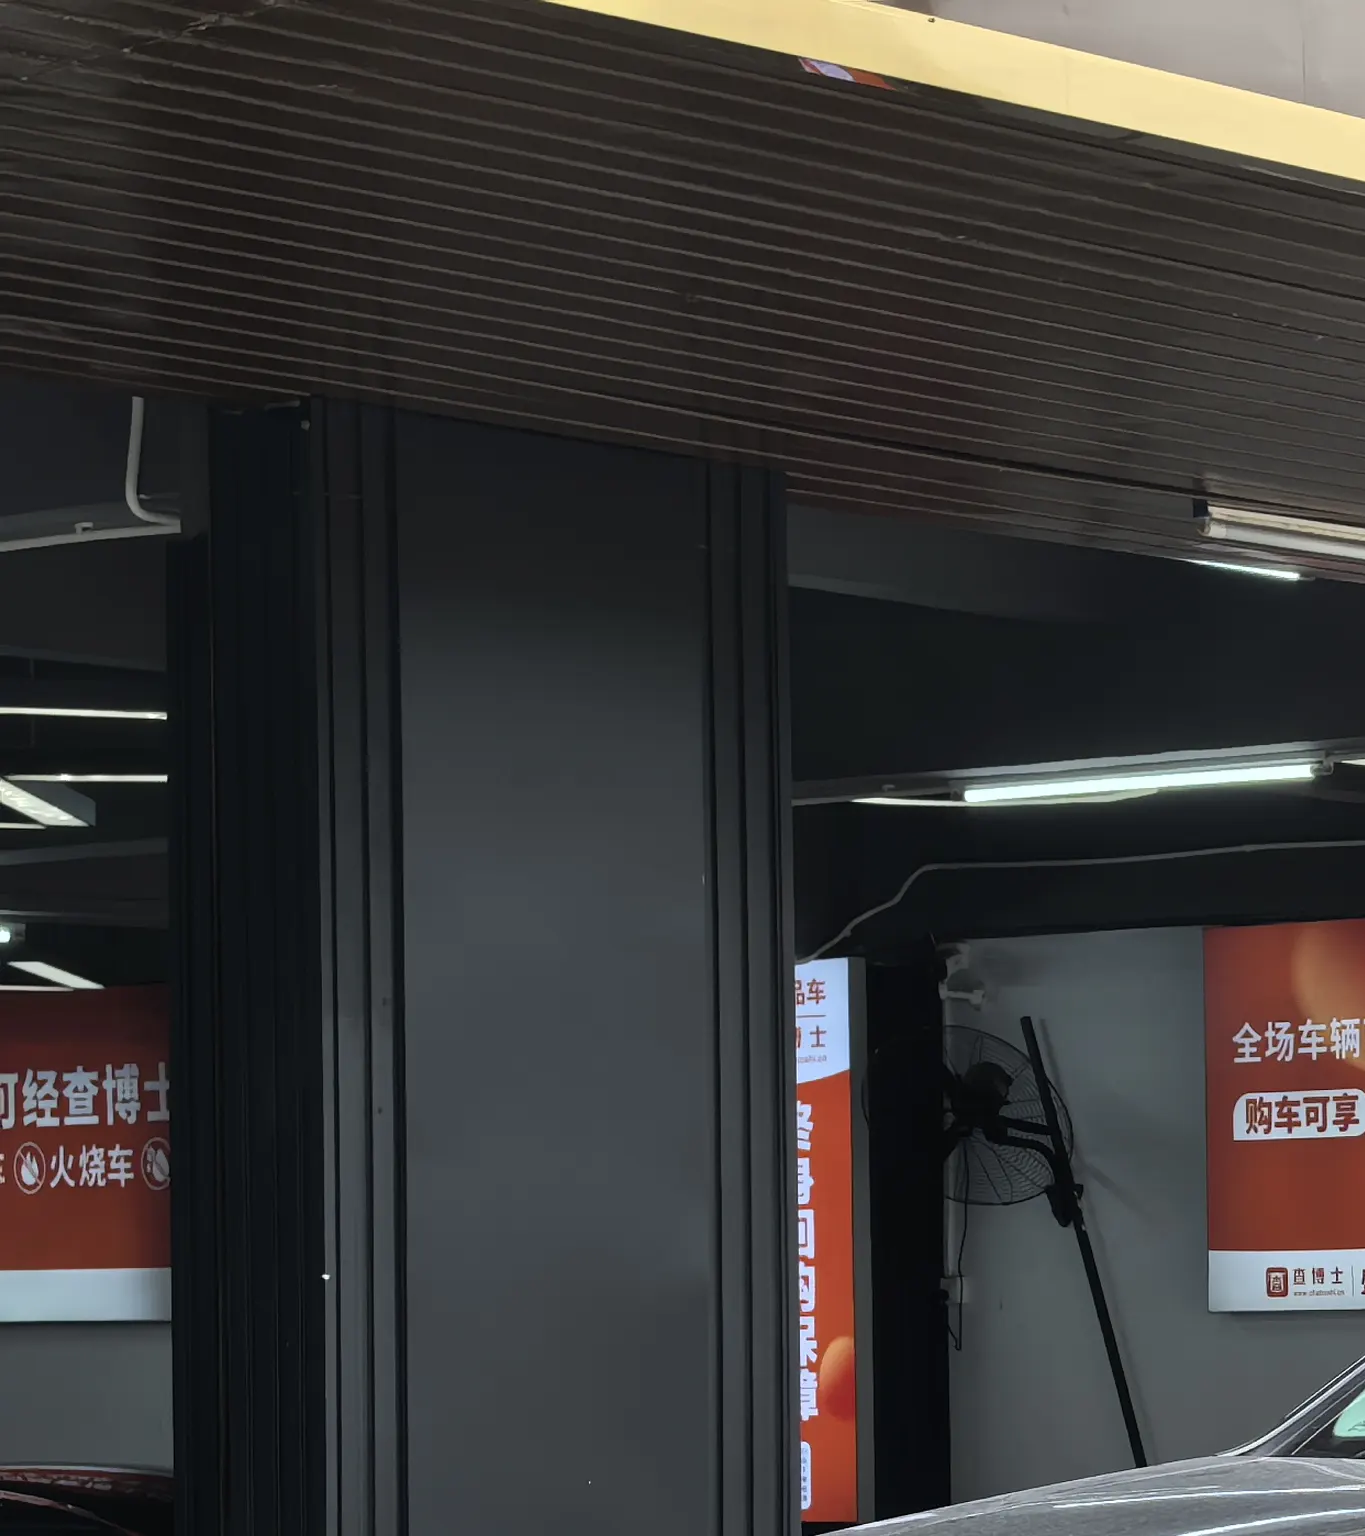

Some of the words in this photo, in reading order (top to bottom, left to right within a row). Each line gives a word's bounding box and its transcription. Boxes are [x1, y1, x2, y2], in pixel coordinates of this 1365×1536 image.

[1244, 1094, 1361, 1136] 购车可享
[50, 1143, 135, 1188] 火烧车
[1293, 1266, 1344, 1286] 查博士
